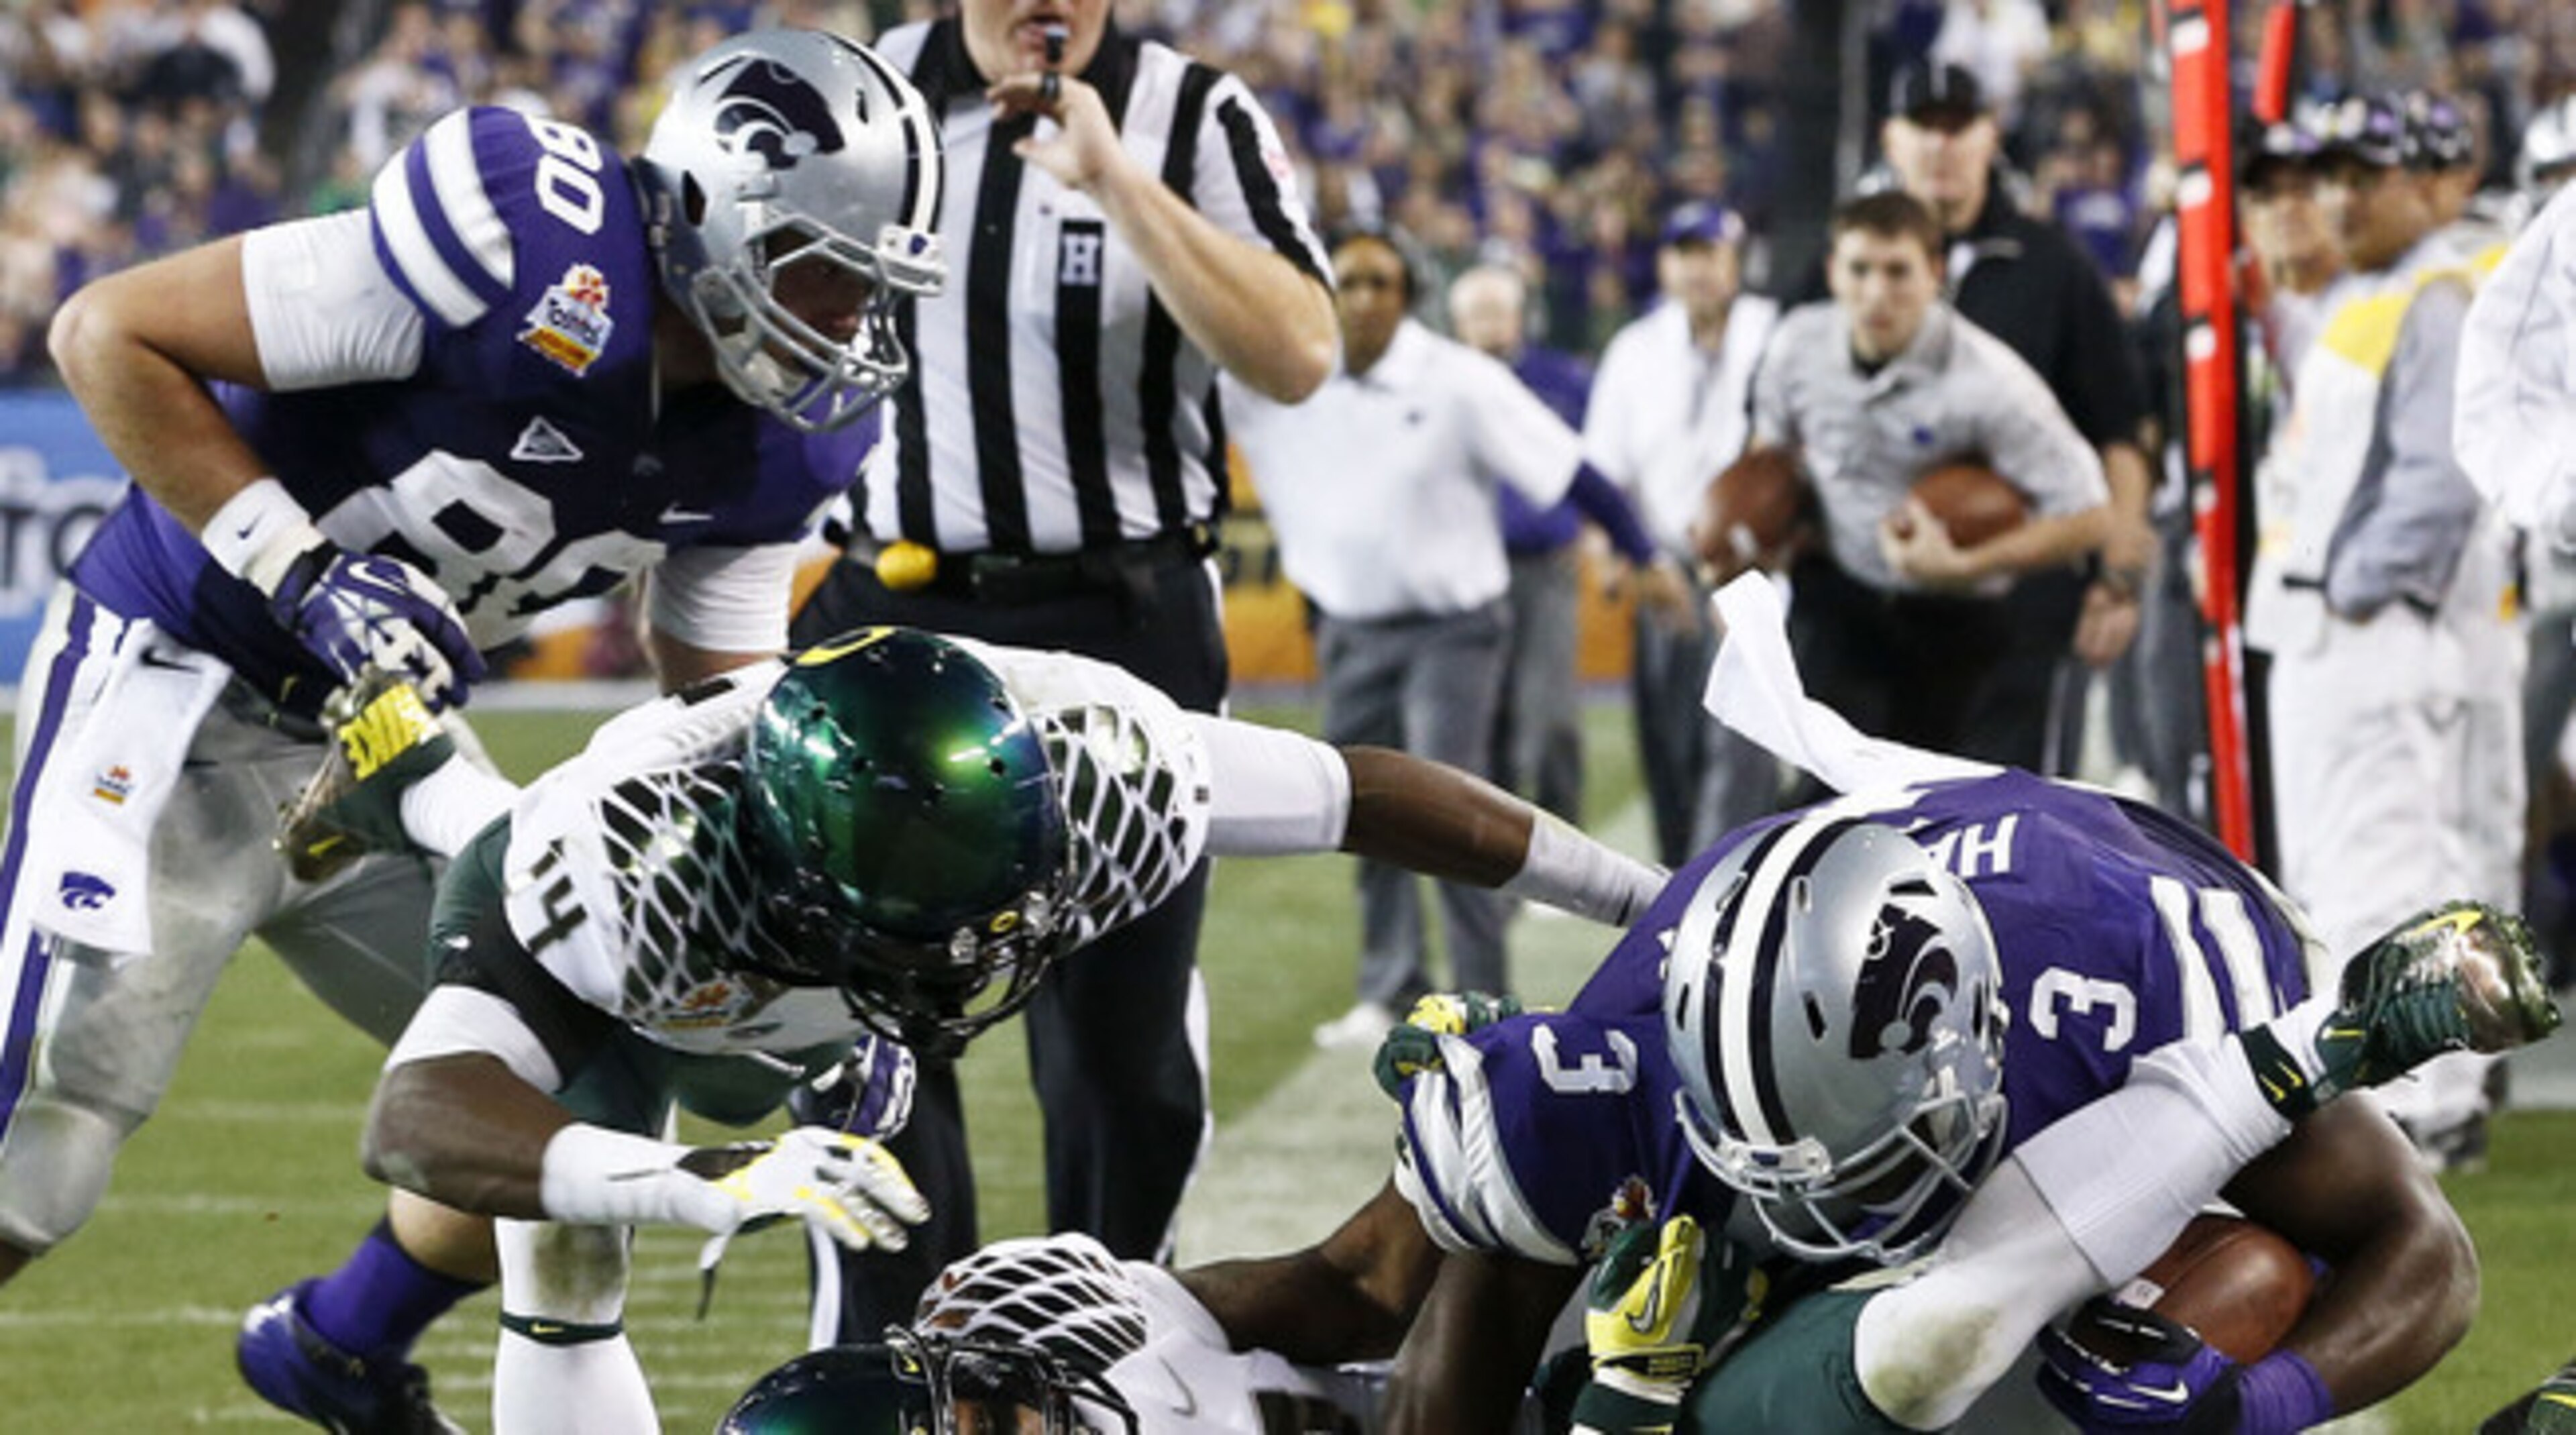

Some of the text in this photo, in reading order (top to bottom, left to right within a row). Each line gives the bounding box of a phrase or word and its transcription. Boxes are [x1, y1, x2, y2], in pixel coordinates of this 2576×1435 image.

[525, 114, 604, 235] 80
[1062, 233, 1099, 284] H
[527, 837, 588, 957] 14
[2029, 966, 2137, 1052] 3
[1529, 1022, 1638, 1094] 3
